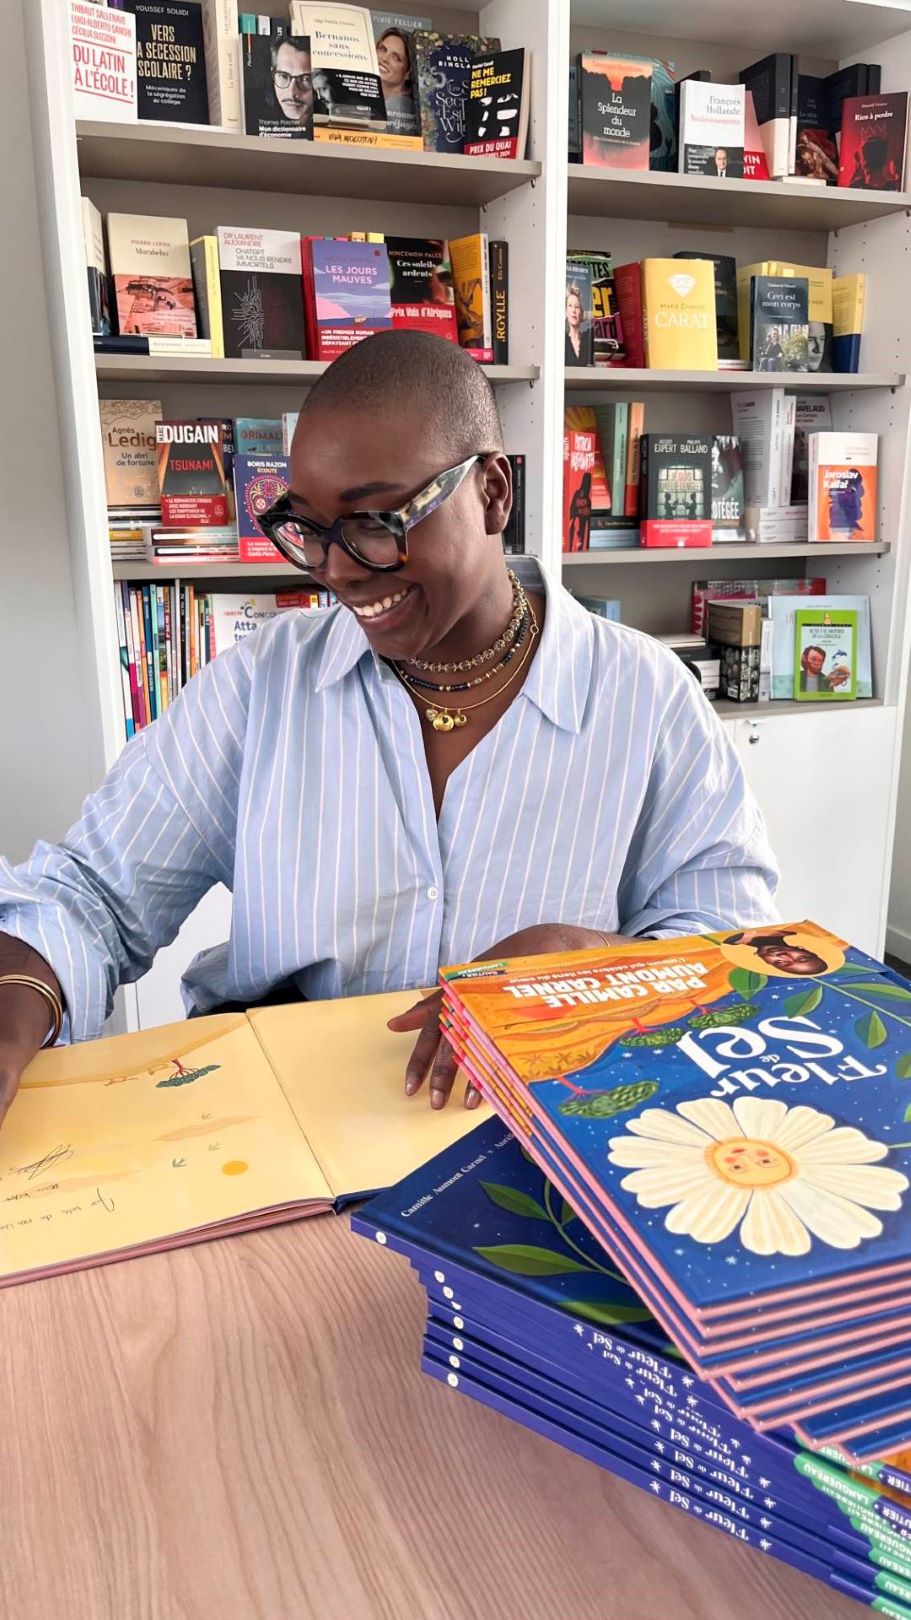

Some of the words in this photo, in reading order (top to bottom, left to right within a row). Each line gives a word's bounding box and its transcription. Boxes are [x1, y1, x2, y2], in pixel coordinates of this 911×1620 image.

[136, 5, 164, 14] YOUSSEF
[151, 24, 175, 43] VERS
[73, 44, 89, 65] DU
[93, 48, 125, 73] LATIN
[138, 60, 184, 80] SCOLAIRE
[185, 64, 192, 81] ?
[471, 69, 482, 80] NE
[482, 67, 495, 78] ME
[75, 62, 83, 86] À
[85, 67, 128, 96] L'ÉCOLE
[130, 80, 134, 98] !
[470, 73, 512, 89] REMERCIEZ
[470, 88, 483, 99] PAS
[611, 92, 623, 104] La
[709, 95, 741, 107] François
[597, 102, 637, 117] Splendeur
[706, 104, 741, 116] Hollande
[854, 113, 869, 121] Rien
[611, 115, 623, 126] du
[603, 127, 631, 138] monde
[469, 145, 484, 154] PRIX
[485, 143, 496, 152] DU
[223, 239, 263, 248] ALEXANDRE
[325, 265, 342, 274] LES
[345, 266, 378, 276] JOURS
[332, 274, 373, 285] MAUVES
[402, 268, 433, 278] ardents
[390, 307, 405, 318] Prix
[405, 307, 419, 318] Voix
[762, 300, 779, 309] mon
[780, 300, 801, 311] corps
[495, 290, 506, 343] RGYLLE
[655, 311, 709, 329] CARAT
[107, 432, 157, 452] Ledig
[164, 425, 219, 444] DUGAIN
[121, 451, 132, 460] Un
[133, 452, 149, 460] abri
[654, 444, 678, 453] EXPERT
[680, 445, 709, 454] BALLAND
[127, 459, 155, 467] fortune
[170, 460, 213, 471] TSUNAMI
[606, 963, 709, 988] AUMONT
[502, 974, 603, 999] CARNEL
[653, 976, 707, 994] PAR
[547, 983, 650, 1008] CAMILLE
[676, 1015, 844, 1081] Sel
[761, 1053, 780, 1065] de
[709, 1055, 888, 1099] Fleur
[401, 1194, 434, 1217] Camille
[432, 1171, 464, 1195] Aumont
[460, 1154, 487, 1174] Carnel
[593, 1332, 613, 1351] Sel
[627, 1350, 673, 1380] Fleur
[670, 1428, 690, 1447] Sel
[674, 1450, 694, 1469] Sel
[705, 1449, 749, 1478] Fleur
[670, 1469, 690, 1488] Sel
[709, 1469, 754, 1499] Fleur
[804, 1463, 870, 1506] LANGUEREAU
[669, 1490, 690, 1510] Sel
[705, 1489, 750, 1519] Fleur
[705, 1511, 750, 1541] Fleur
